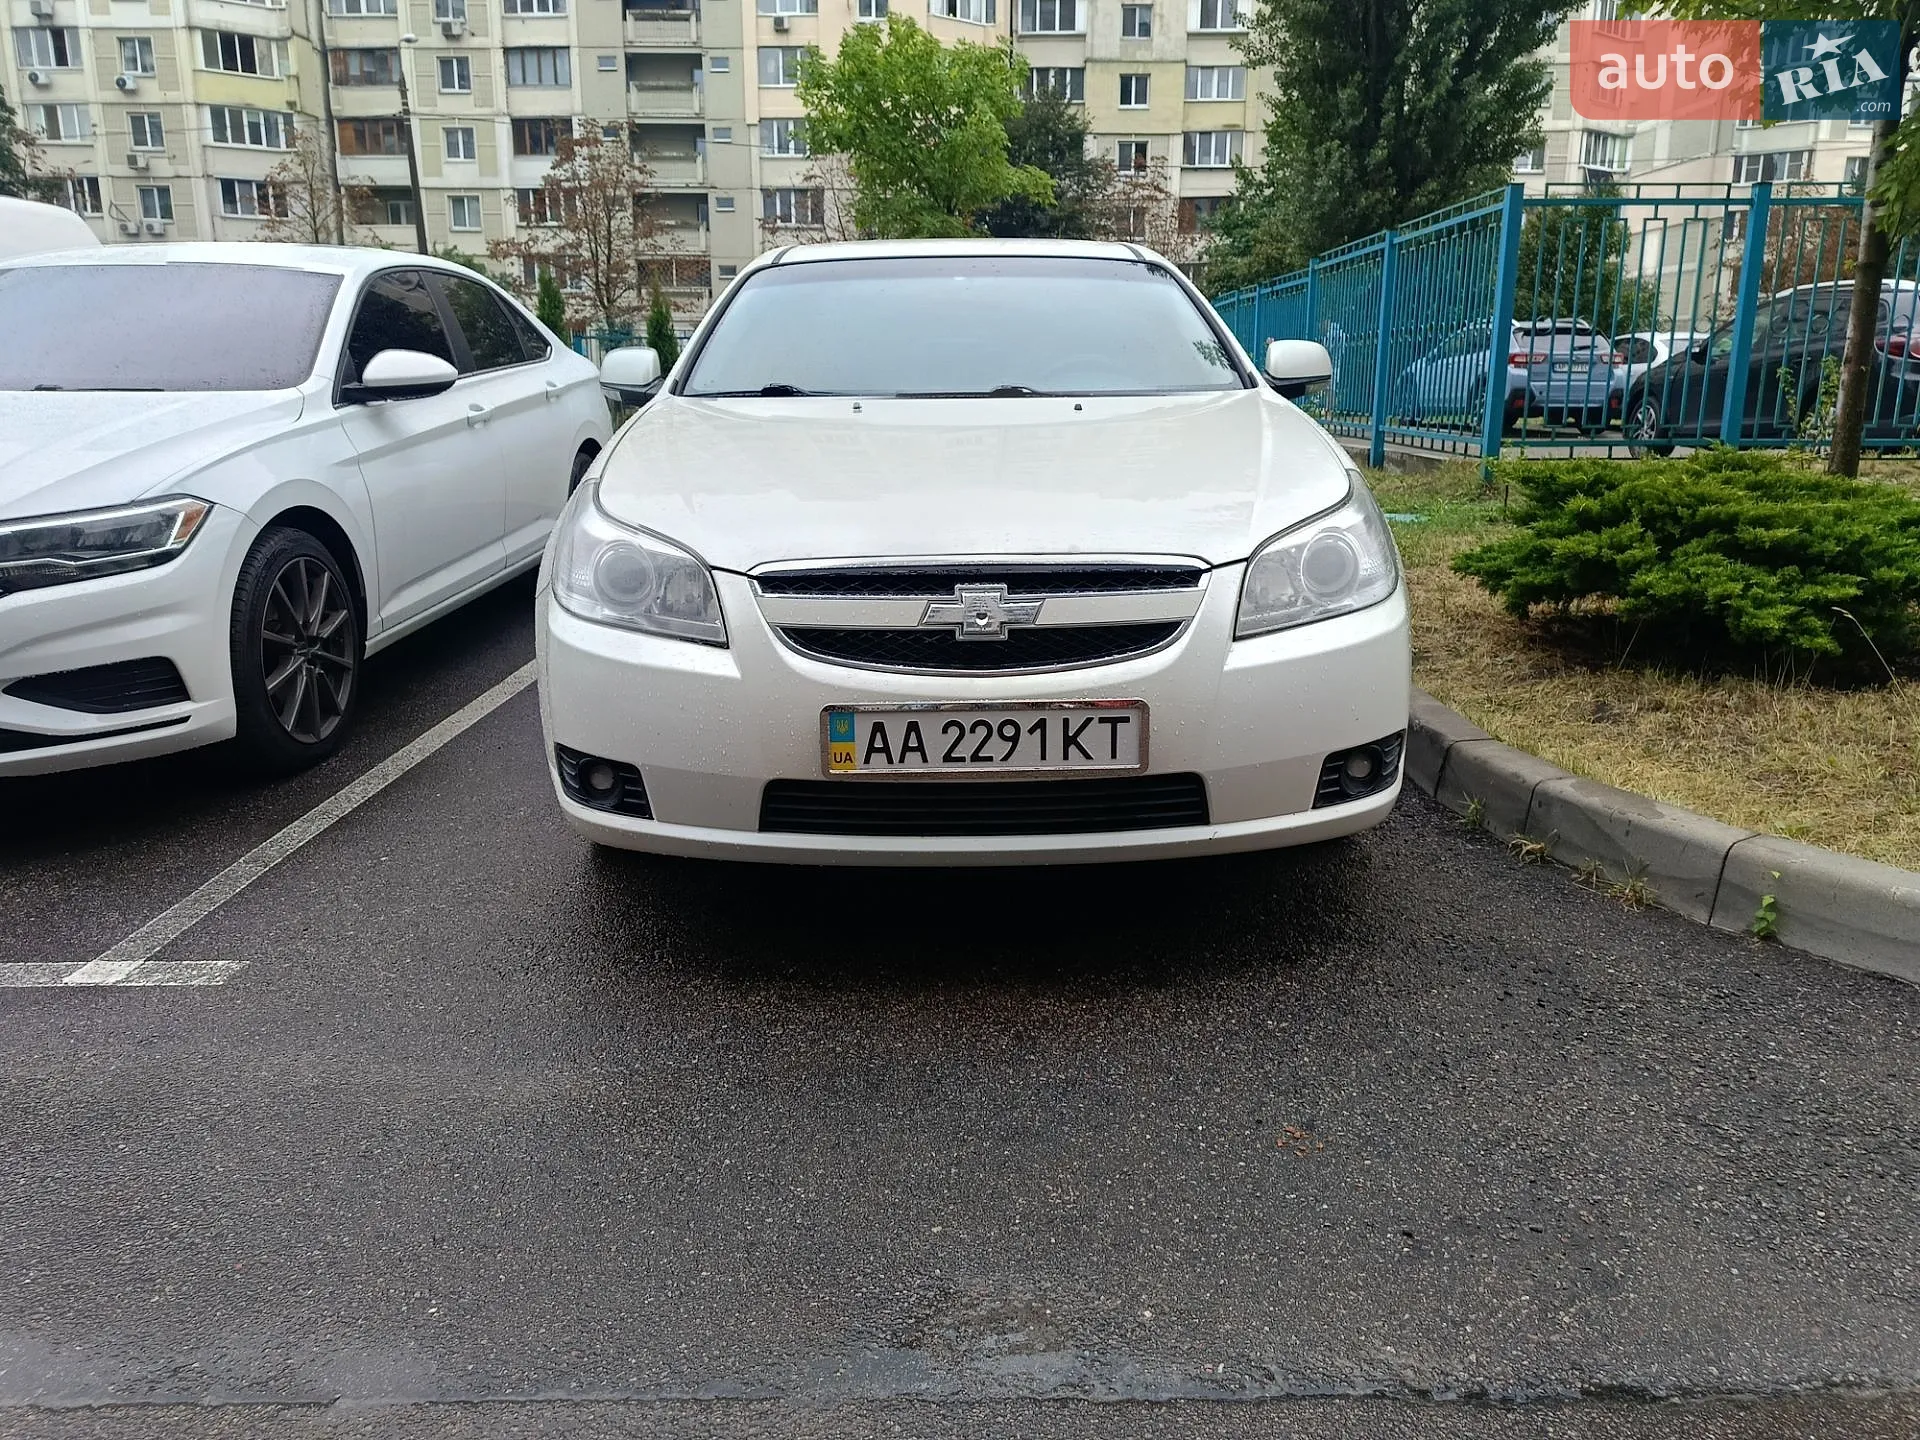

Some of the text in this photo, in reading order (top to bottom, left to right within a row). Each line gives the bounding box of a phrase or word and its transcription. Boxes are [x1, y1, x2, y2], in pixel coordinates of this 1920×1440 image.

[863, 716, 1131, 765] AA 2291 KT
[833, 753, 854, 764] UA
